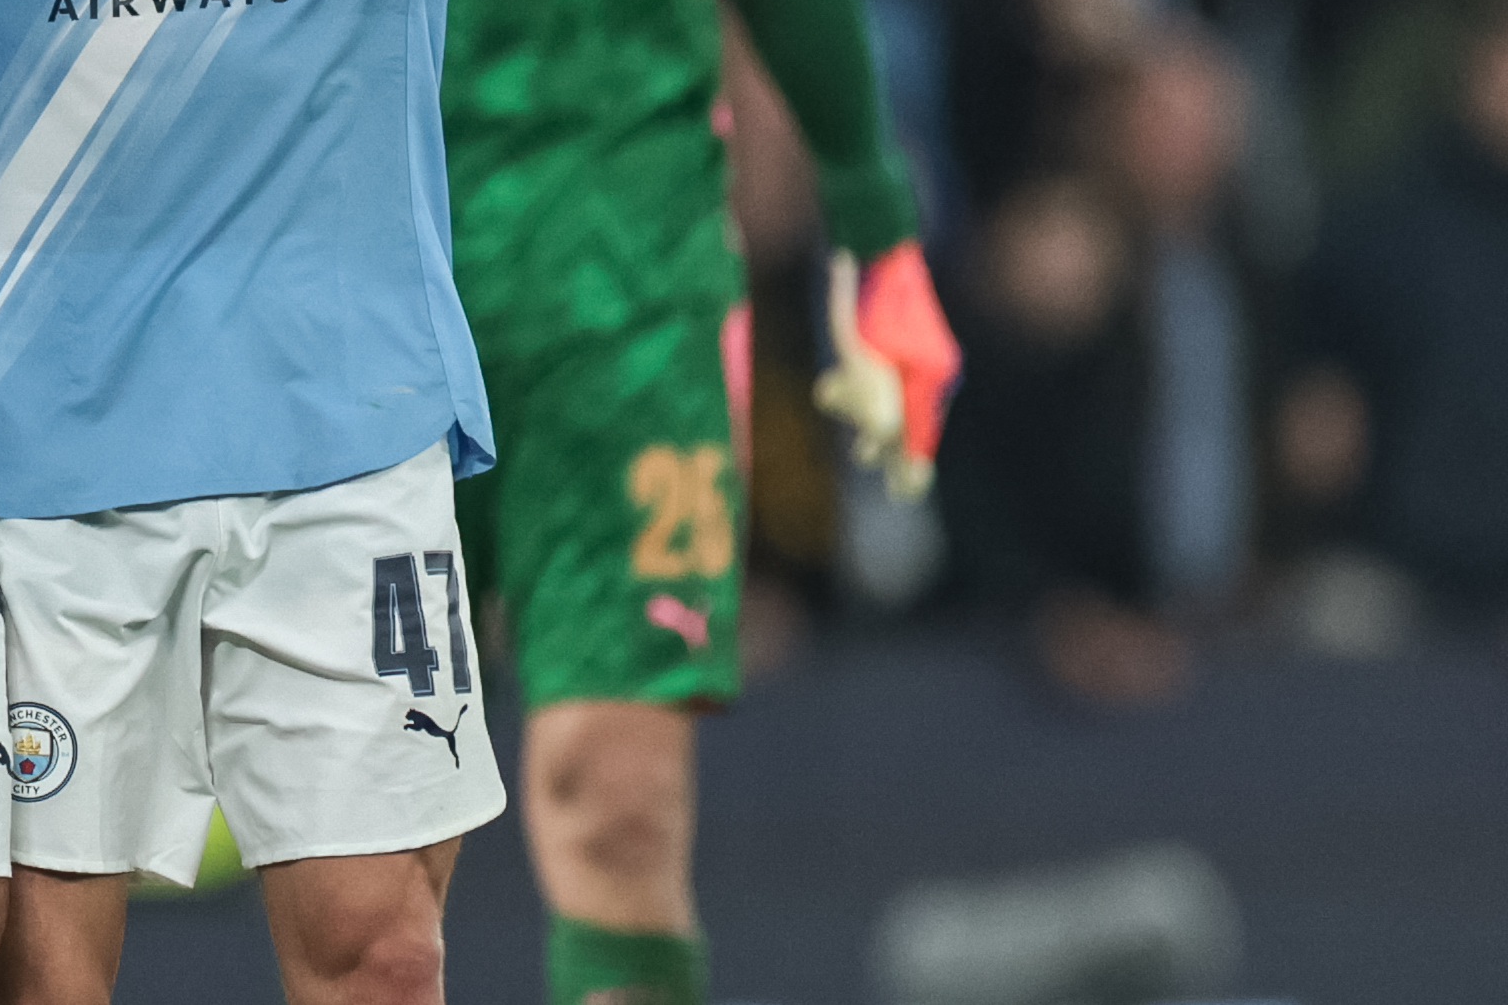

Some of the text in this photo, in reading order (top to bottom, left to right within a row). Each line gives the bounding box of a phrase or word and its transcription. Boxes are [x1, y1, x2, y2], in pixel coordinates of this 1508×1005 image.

[372, 550, 472, 697] 47
[9, 709, 68, 742] NCHESTER
[13, 784, 40, 795] CITY
